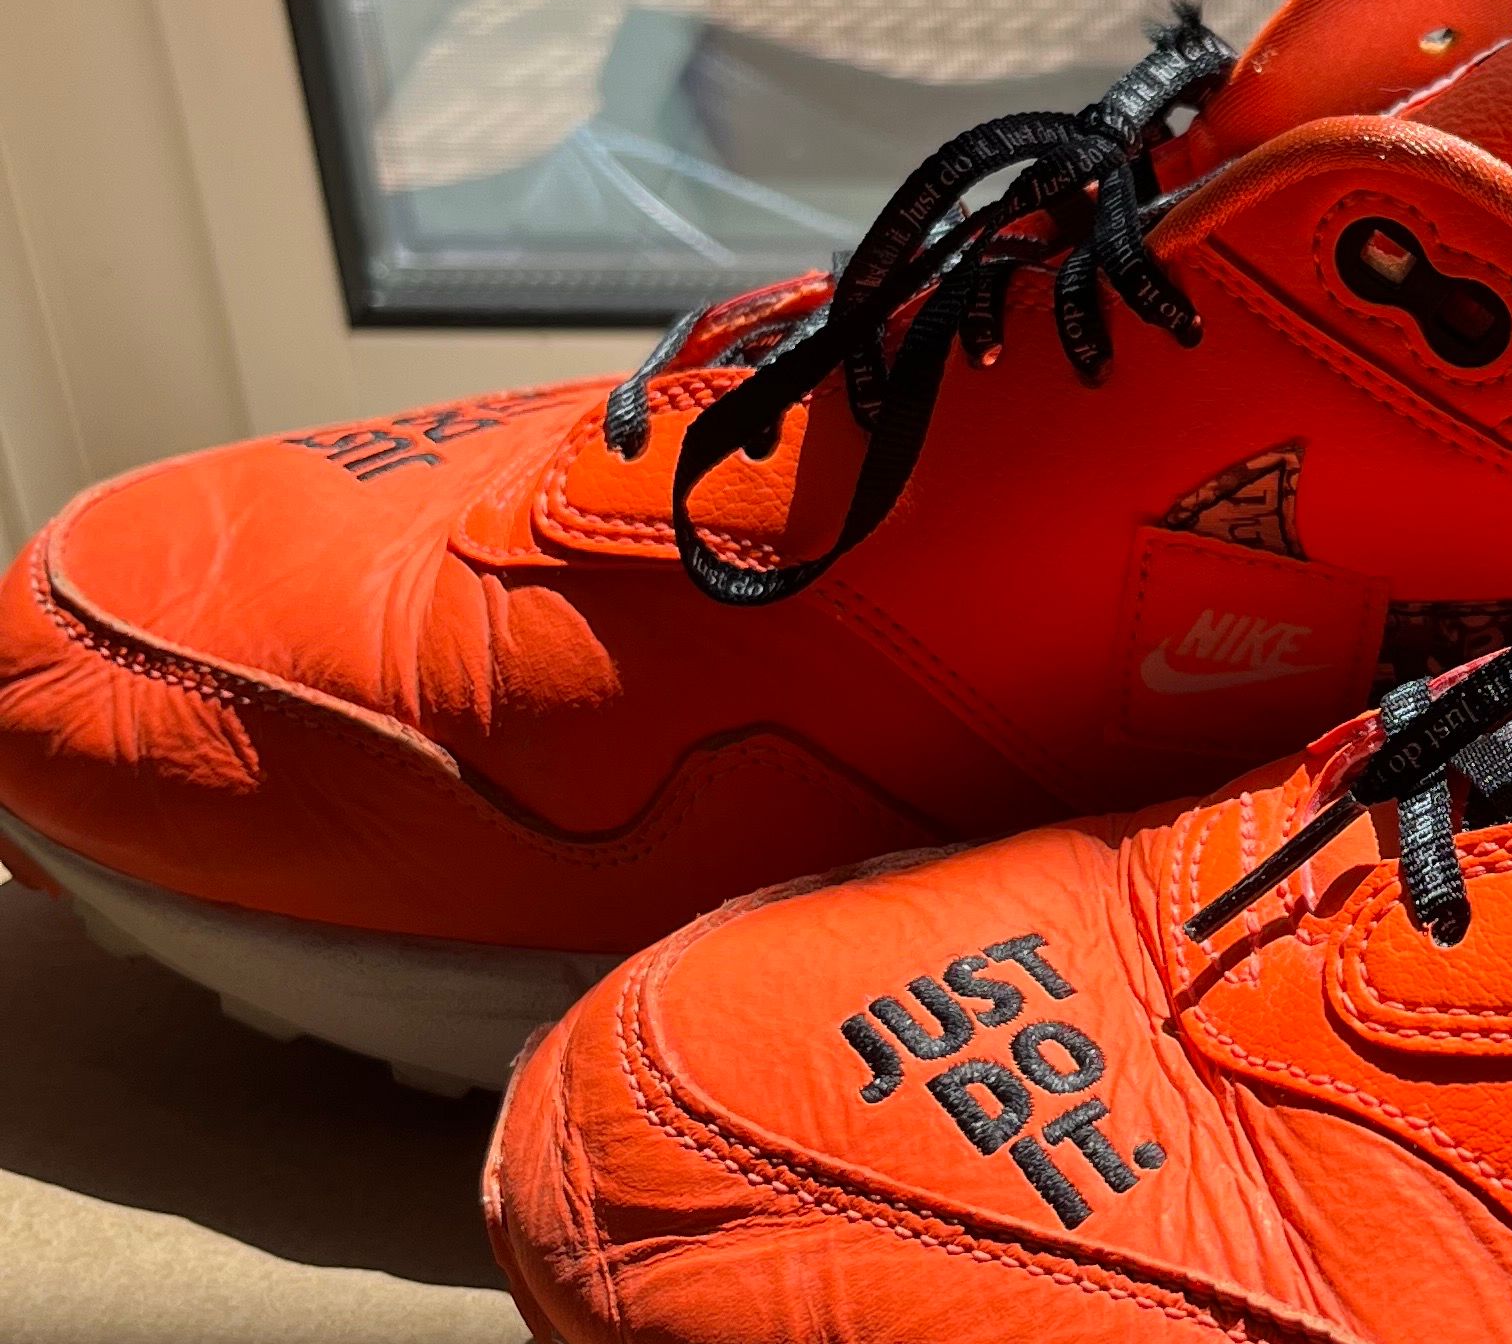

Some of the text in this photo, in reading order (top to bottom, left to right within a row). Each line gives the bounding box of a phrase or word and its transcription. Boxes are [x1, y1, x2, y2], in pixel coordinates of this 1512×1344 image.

[899, 178, 942, 230] Just
[940, 153, 973, 186] do
[1175, 608, 1313, 668] NIKE
[840, 933, 1077, 1104] JUST
[926, 1021, 1105, 1156] DO
[1009, 1096, 1167, 1230] IT.
